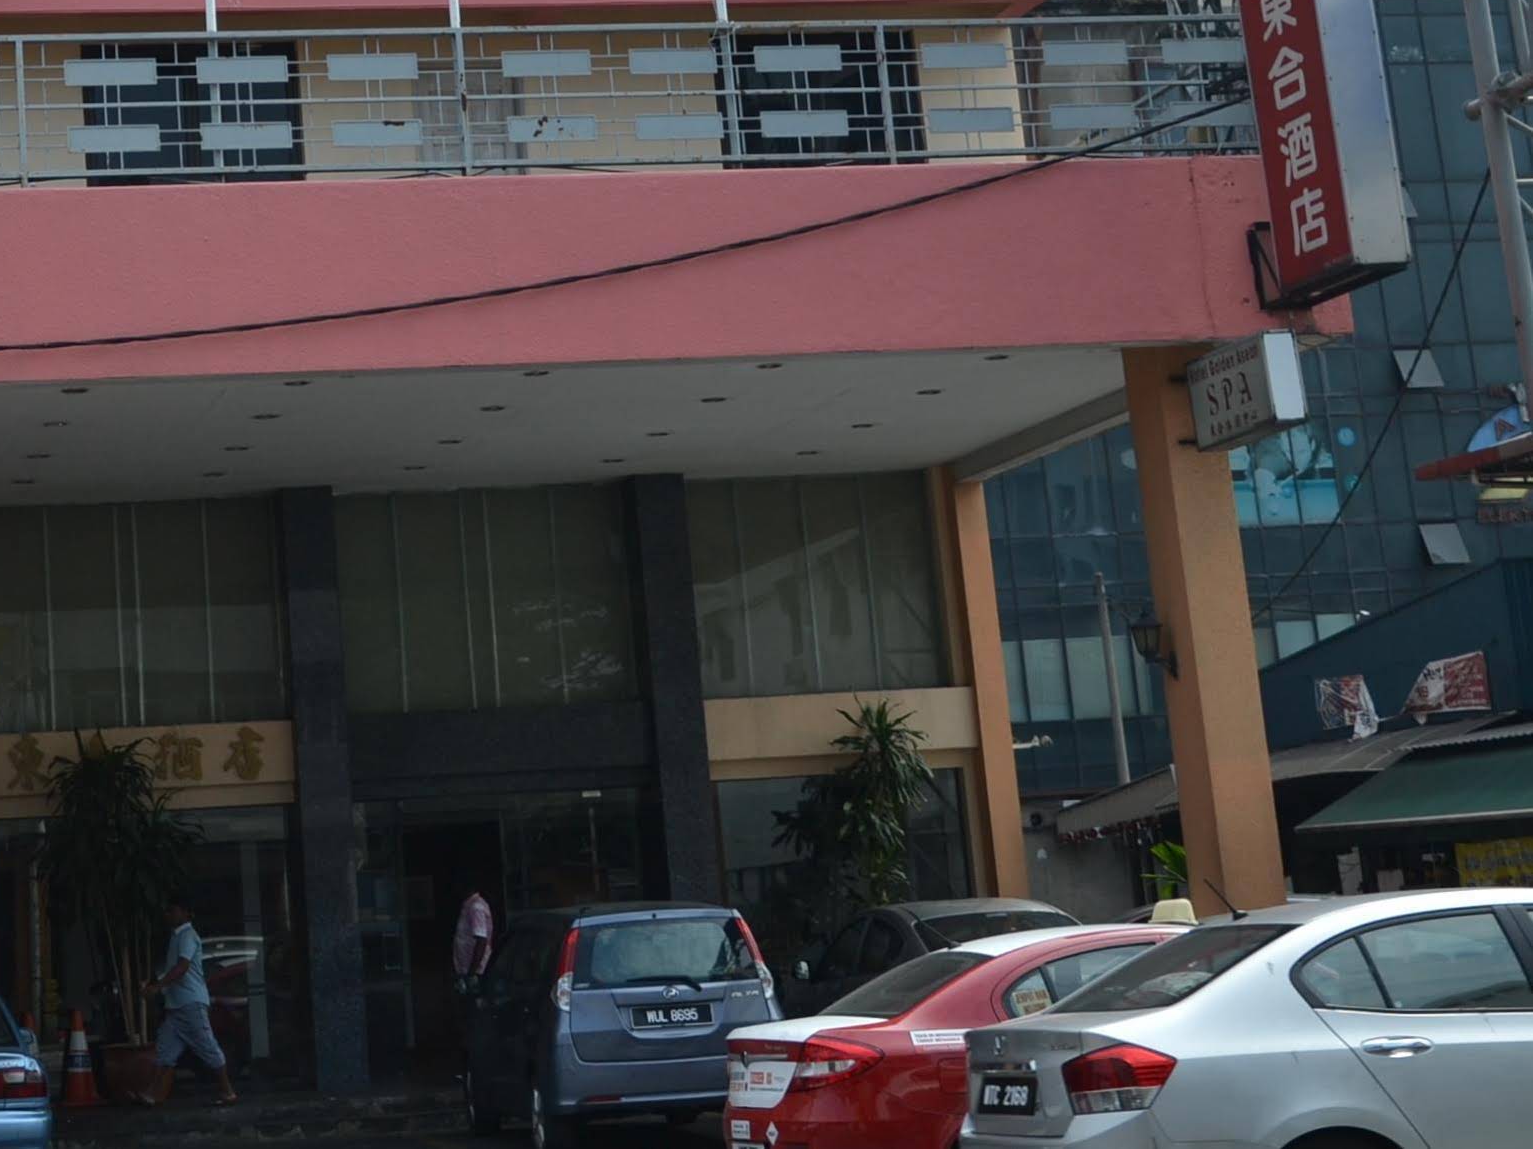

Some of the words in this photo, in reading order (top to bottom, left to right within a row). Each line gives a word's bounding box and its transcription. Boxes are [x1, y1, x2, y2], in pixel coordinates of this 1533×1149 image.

[1206, 371, 1253, 416] SPA
[646, 1009, 669, 1023] WUL
[670, 1007, 699, 1022] 8695
